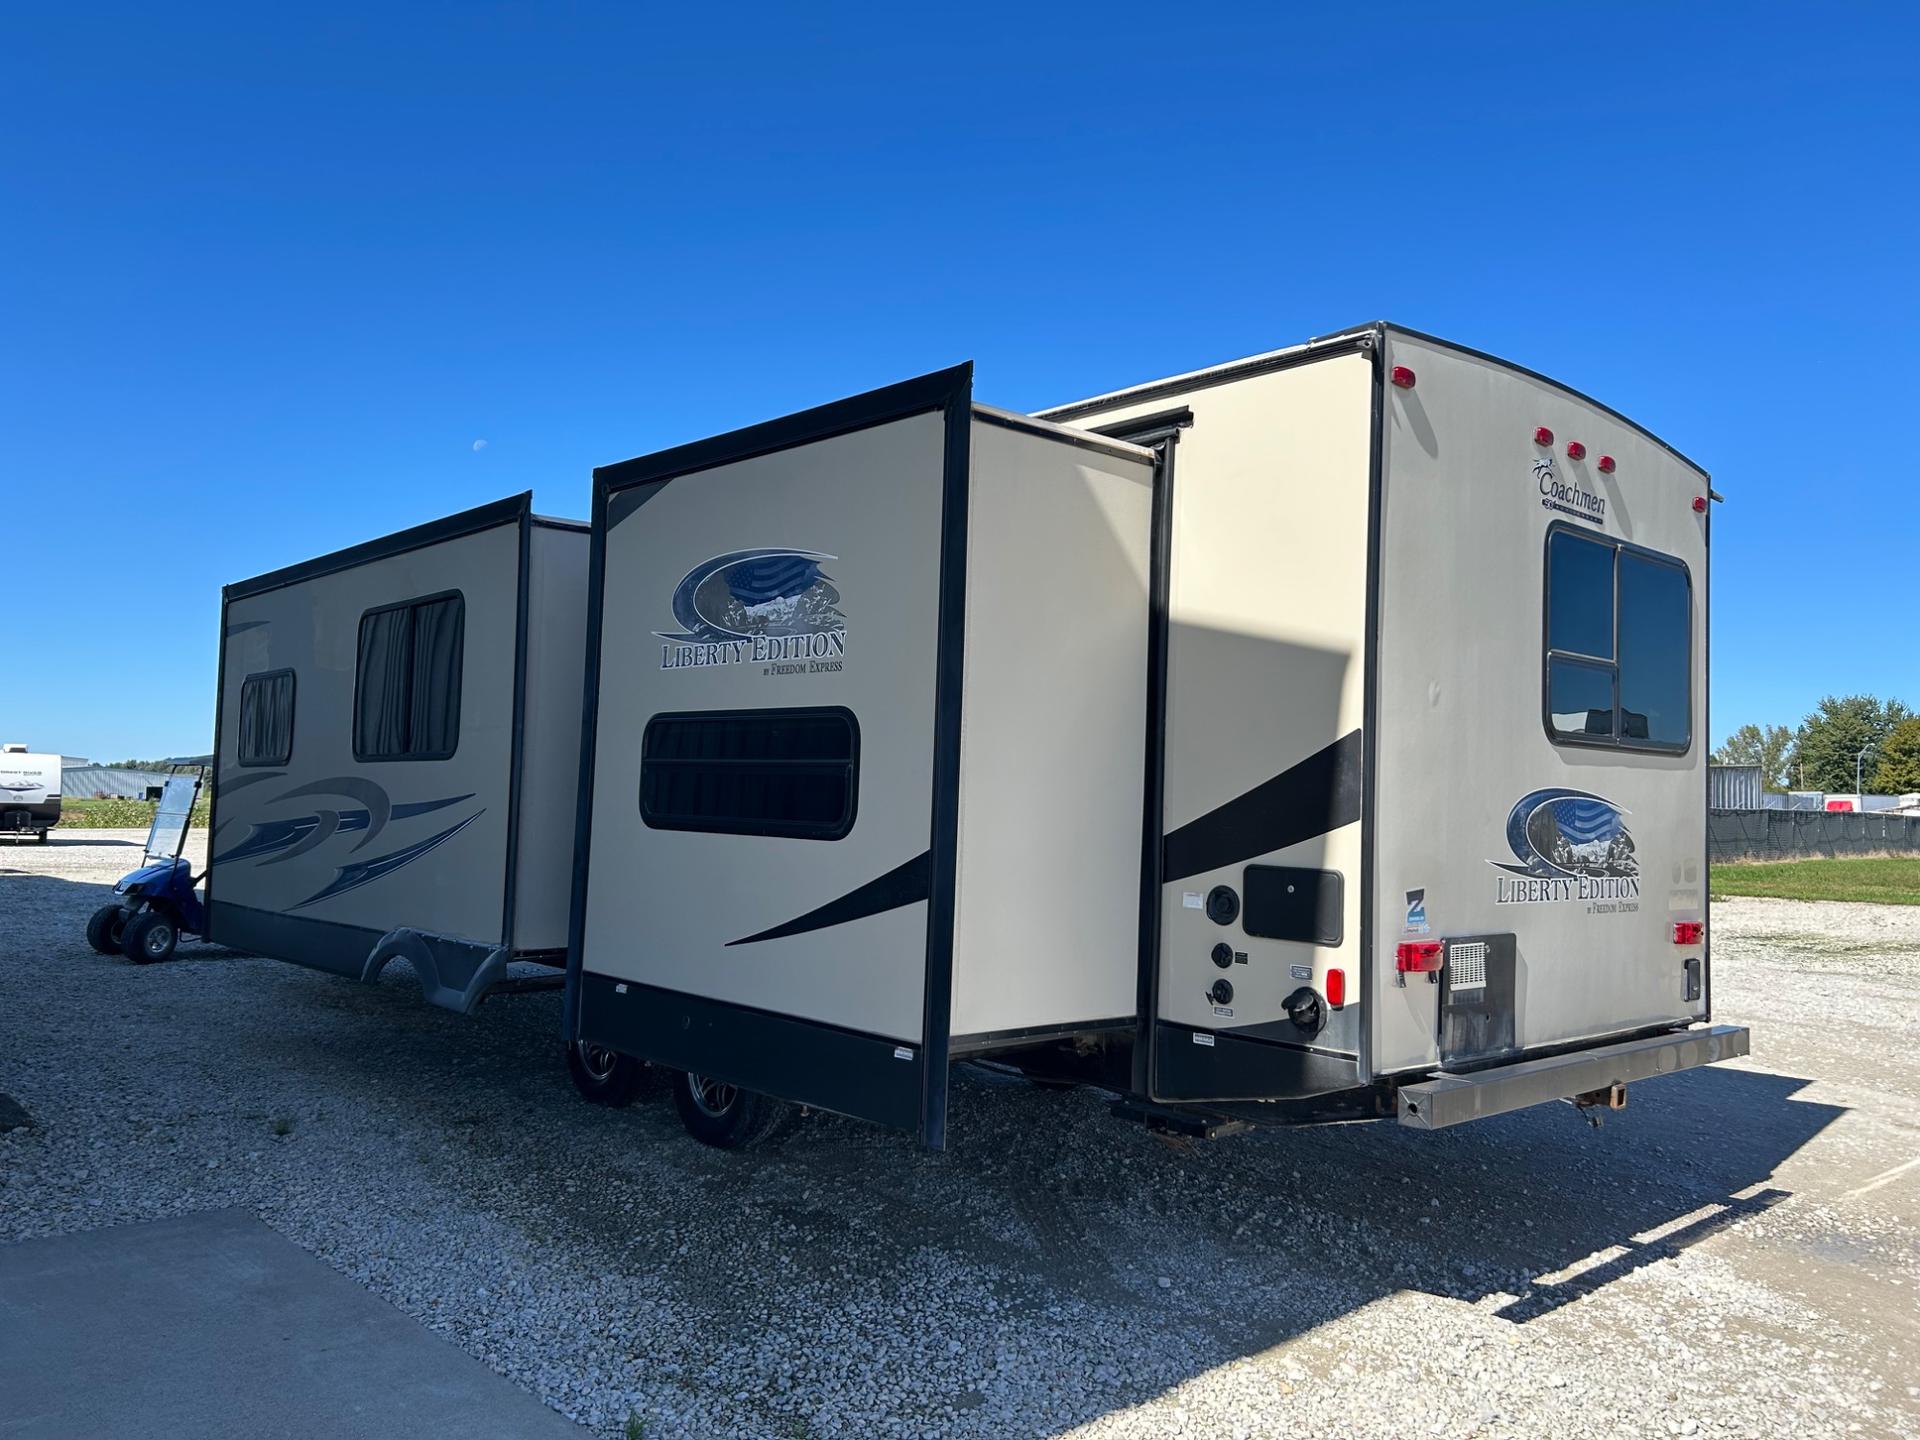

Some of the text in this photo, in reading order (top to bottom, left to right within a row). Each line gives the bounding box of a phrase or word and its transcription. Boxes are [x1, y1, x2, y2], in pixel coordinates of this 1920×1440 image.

[1539, 472, 1606, 514] Coachmen
[660, 631, 847, 669] LIBERTY EDITION
[771, 663, 807, 676] FREEDOM
[809, 660, 843, 674] EXPRESS
[1496, 875, 1640, 904] LIBERTY EDITION
